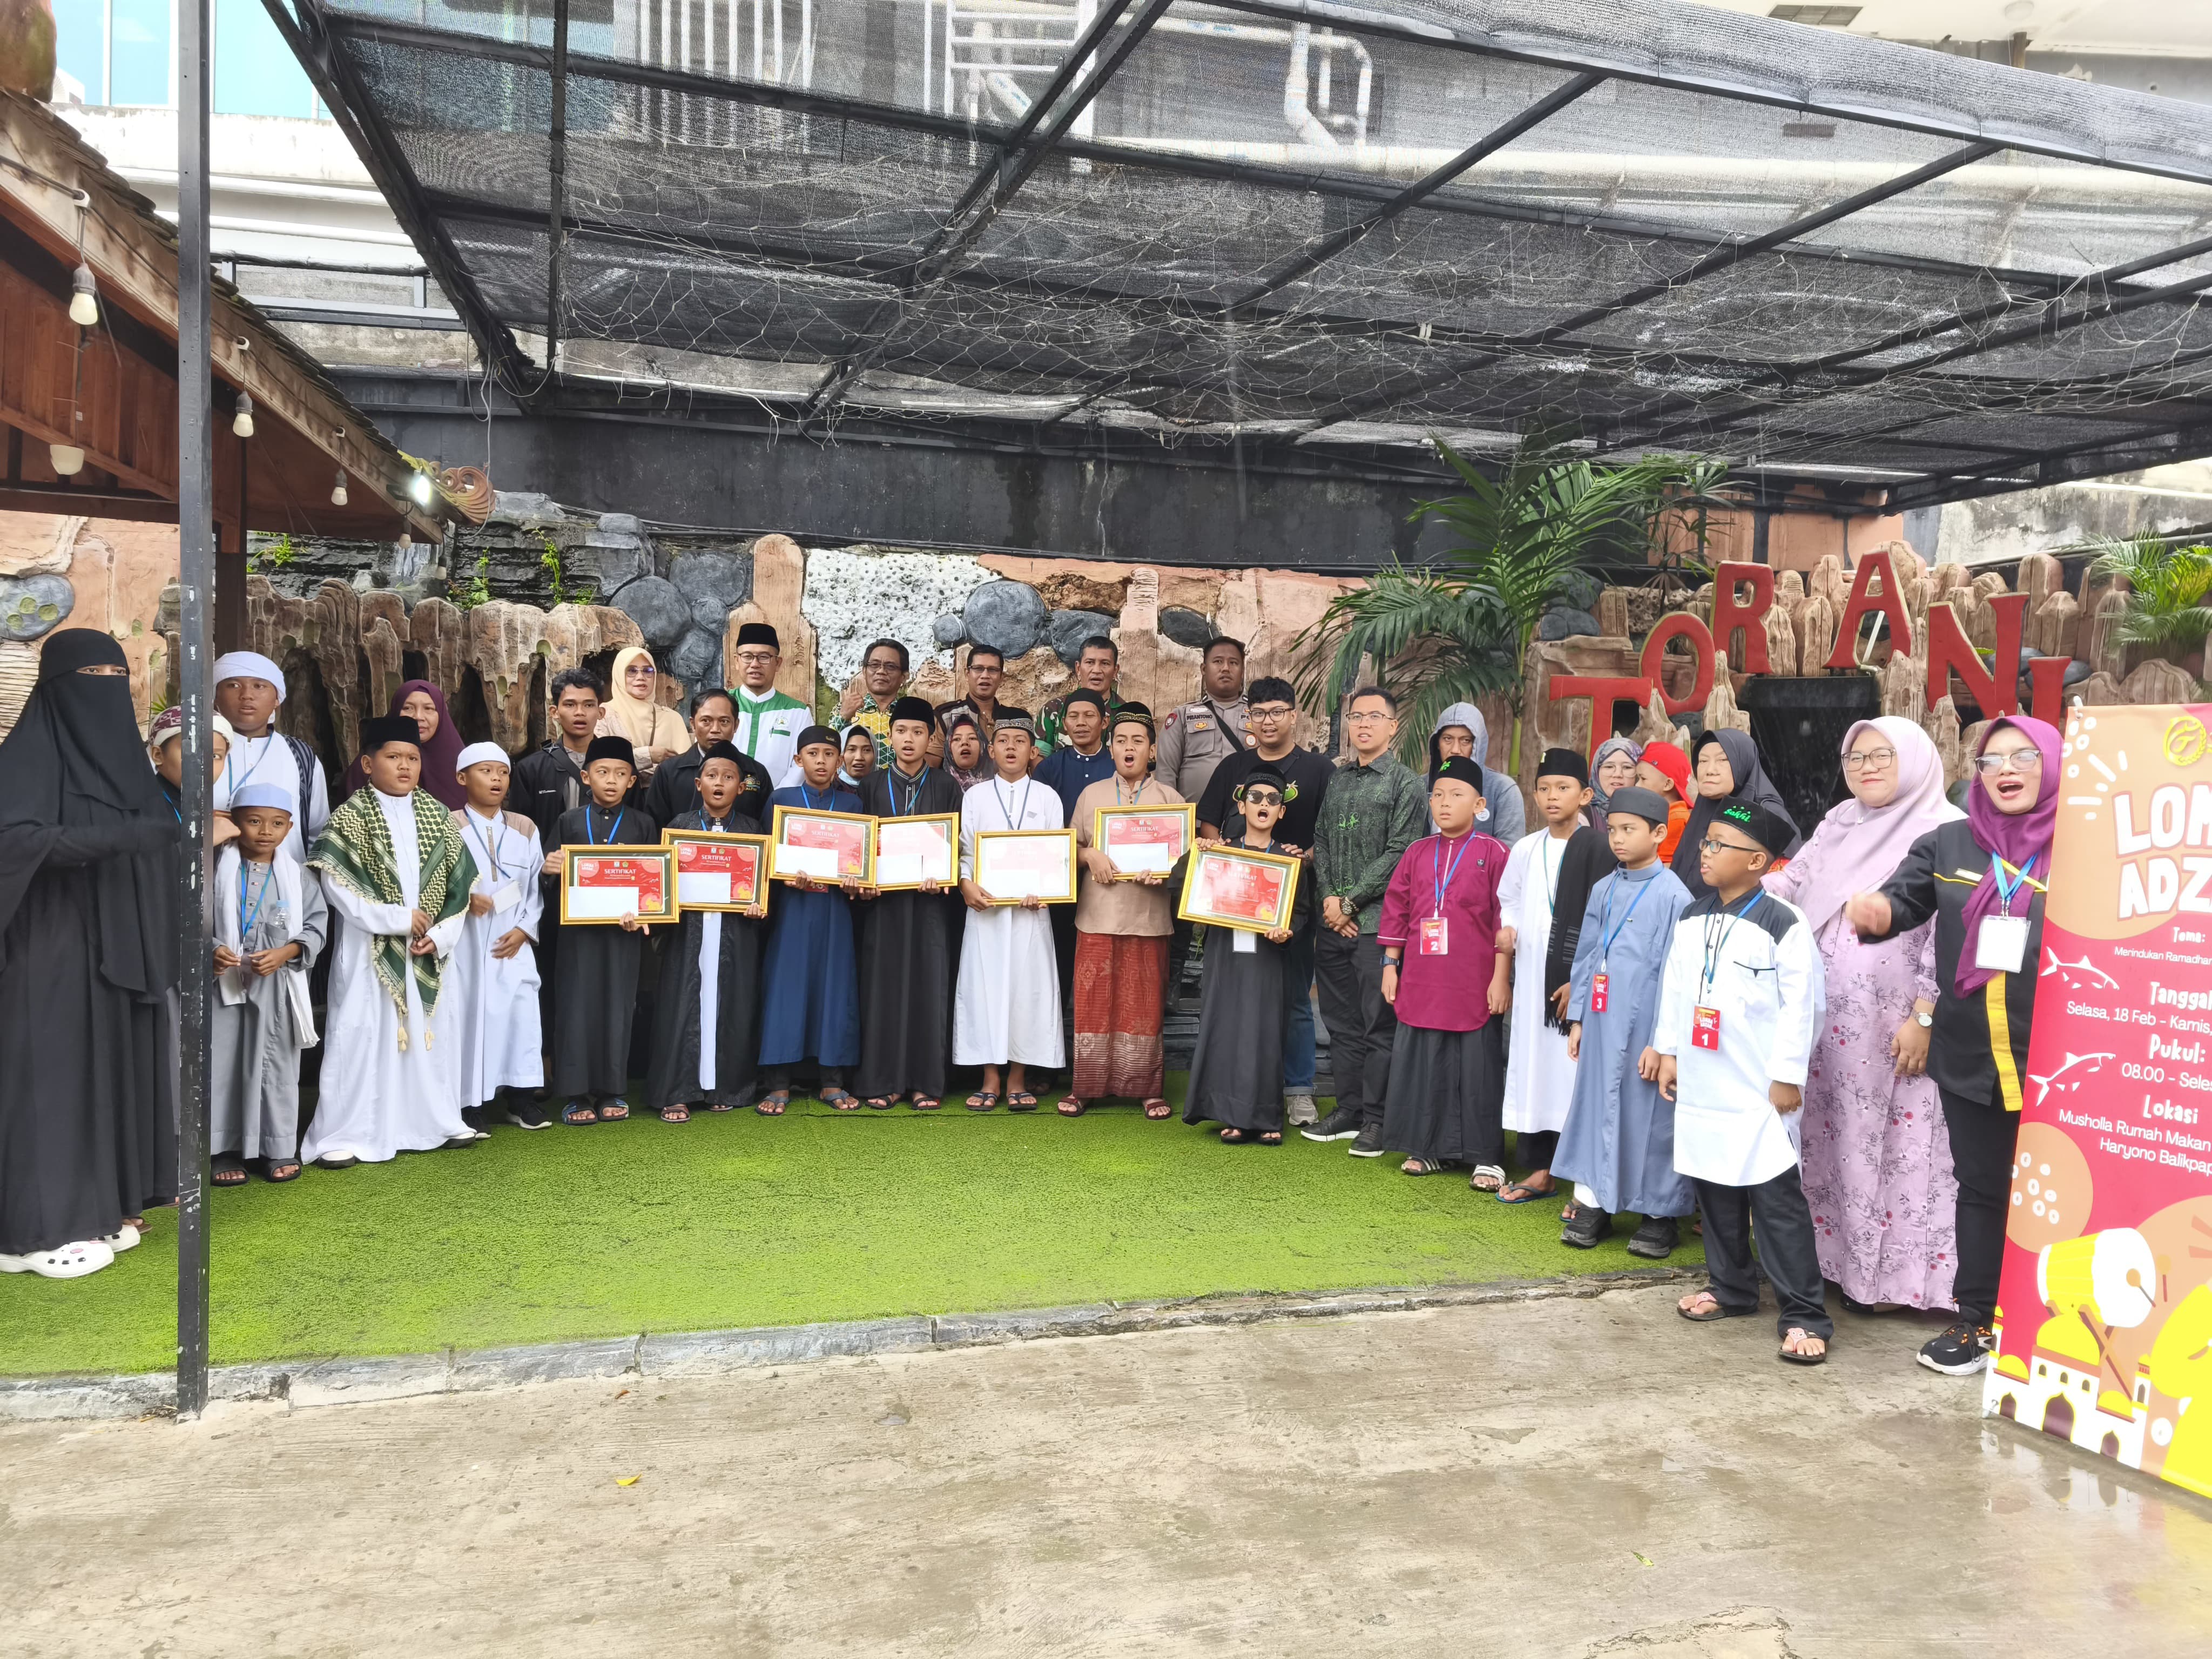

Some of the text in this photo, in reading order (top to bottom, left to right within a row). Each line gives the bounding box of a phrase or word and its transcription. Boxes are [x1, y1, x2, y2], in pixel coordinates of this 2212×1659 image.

[1549, 550, 2071, 775] TORANI
[1431, 941, 1439, 951] 2
[2114, 946, 2164, 960] Merindukan
[1596, 997, 1602, 1009] 3
[2067, 1001, 2110, 1021] Selasa,
[2113, 1008, 2129, 1022] 18
[2132, 1009, 2156, 1026] Feb
[1702, 1033, 1709, 1046] 1
[2149, 1033, 2206, 1064] Pukul:
[2121, 1062, 2165, 1083] 08.00
[2142, 1094, 2198, 1124] Lokasi
[2059, 1109, 2211, 1152] Musholla Rumah Makan
[2100, 1137, 2156, 1162] Haryono
